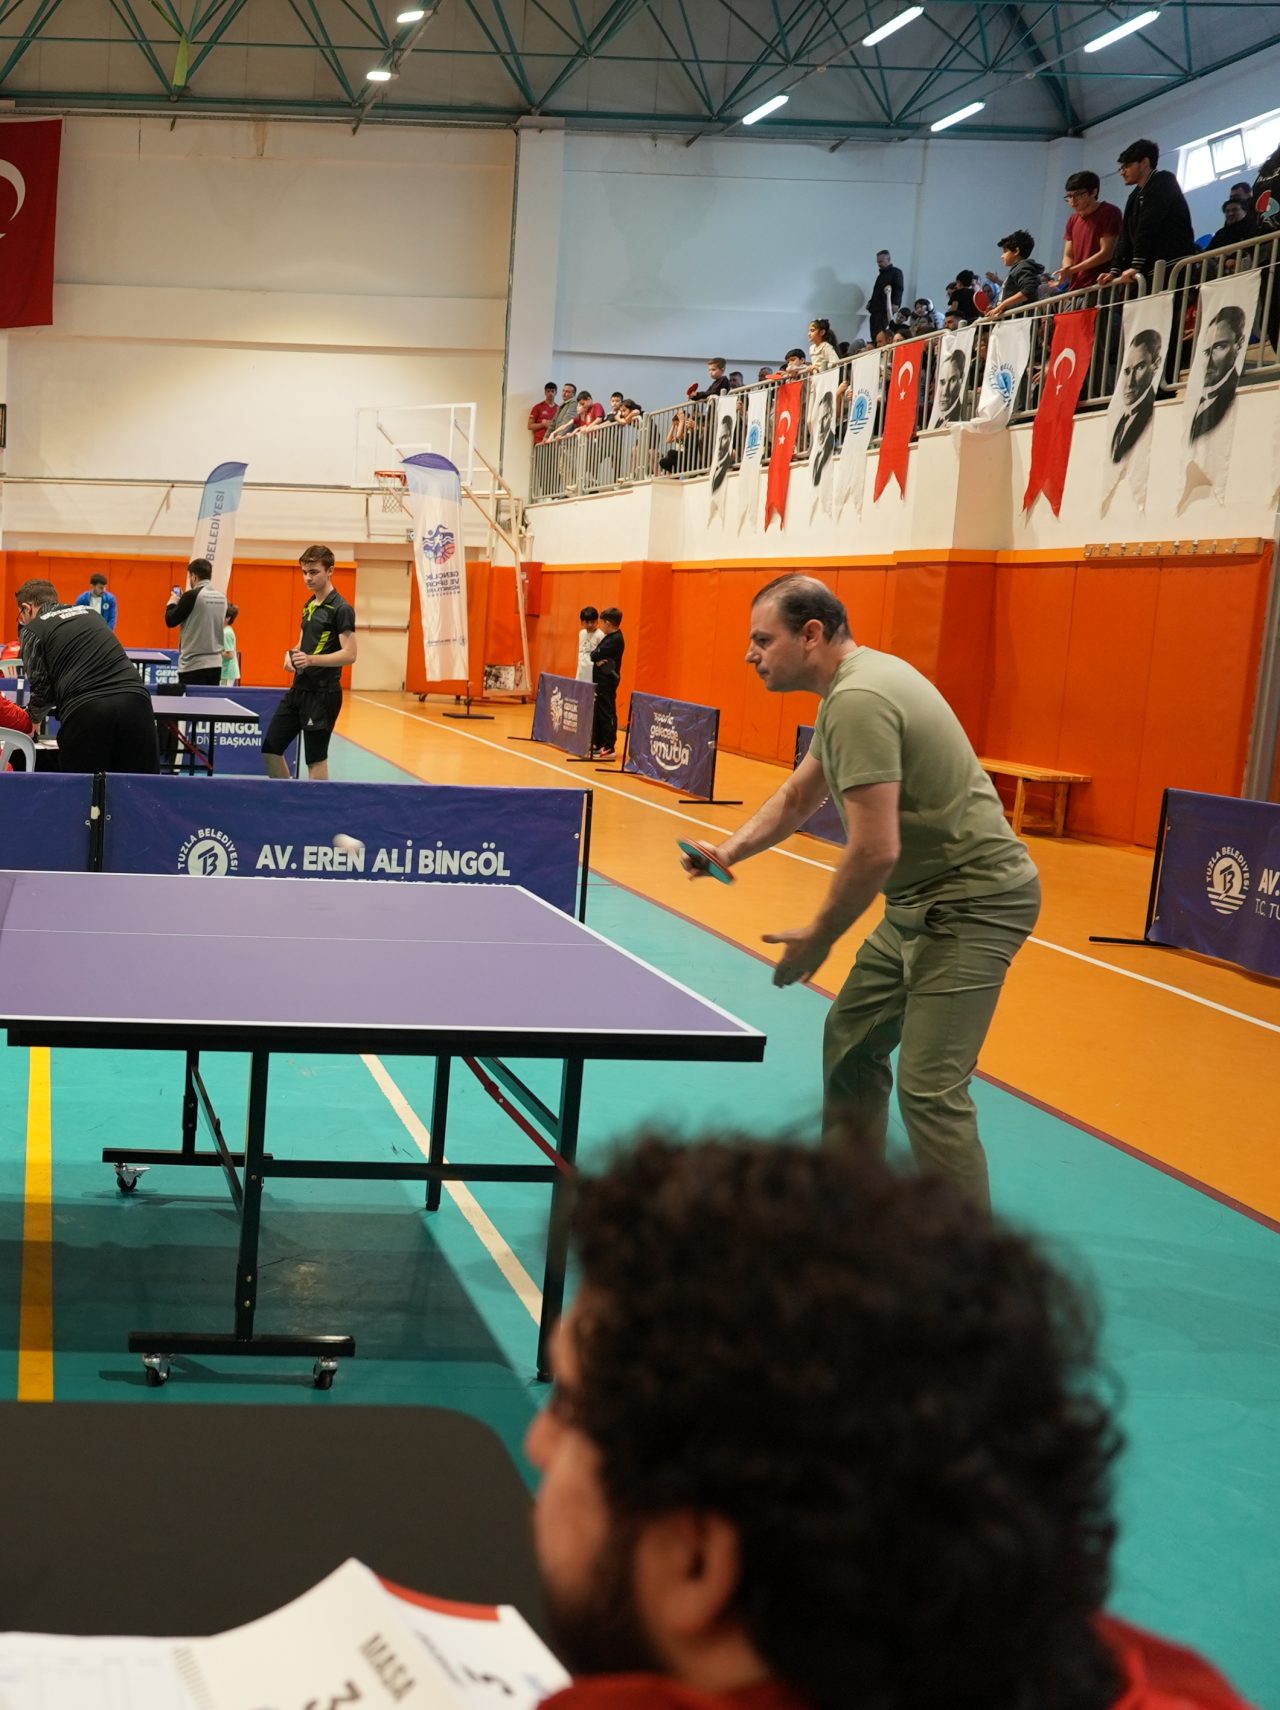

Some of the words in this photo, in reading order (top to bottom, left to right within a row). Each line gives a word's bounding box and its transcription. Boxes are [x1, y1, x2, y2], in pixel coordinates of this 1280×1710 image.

[219, 736, 263, 749] BAŞKANI
[177, 834, 198, 870] TUZLA
[255, 844, 297, 870] AV.
[302, 845, 366, 873] EREN
[371, 839, 413, 874] ALİ
[418, 840, 512, 877] BİNGÖL
[1205, 851, 1222, 883] TUZLA
[1257, 868, 1280, 897] AV.
